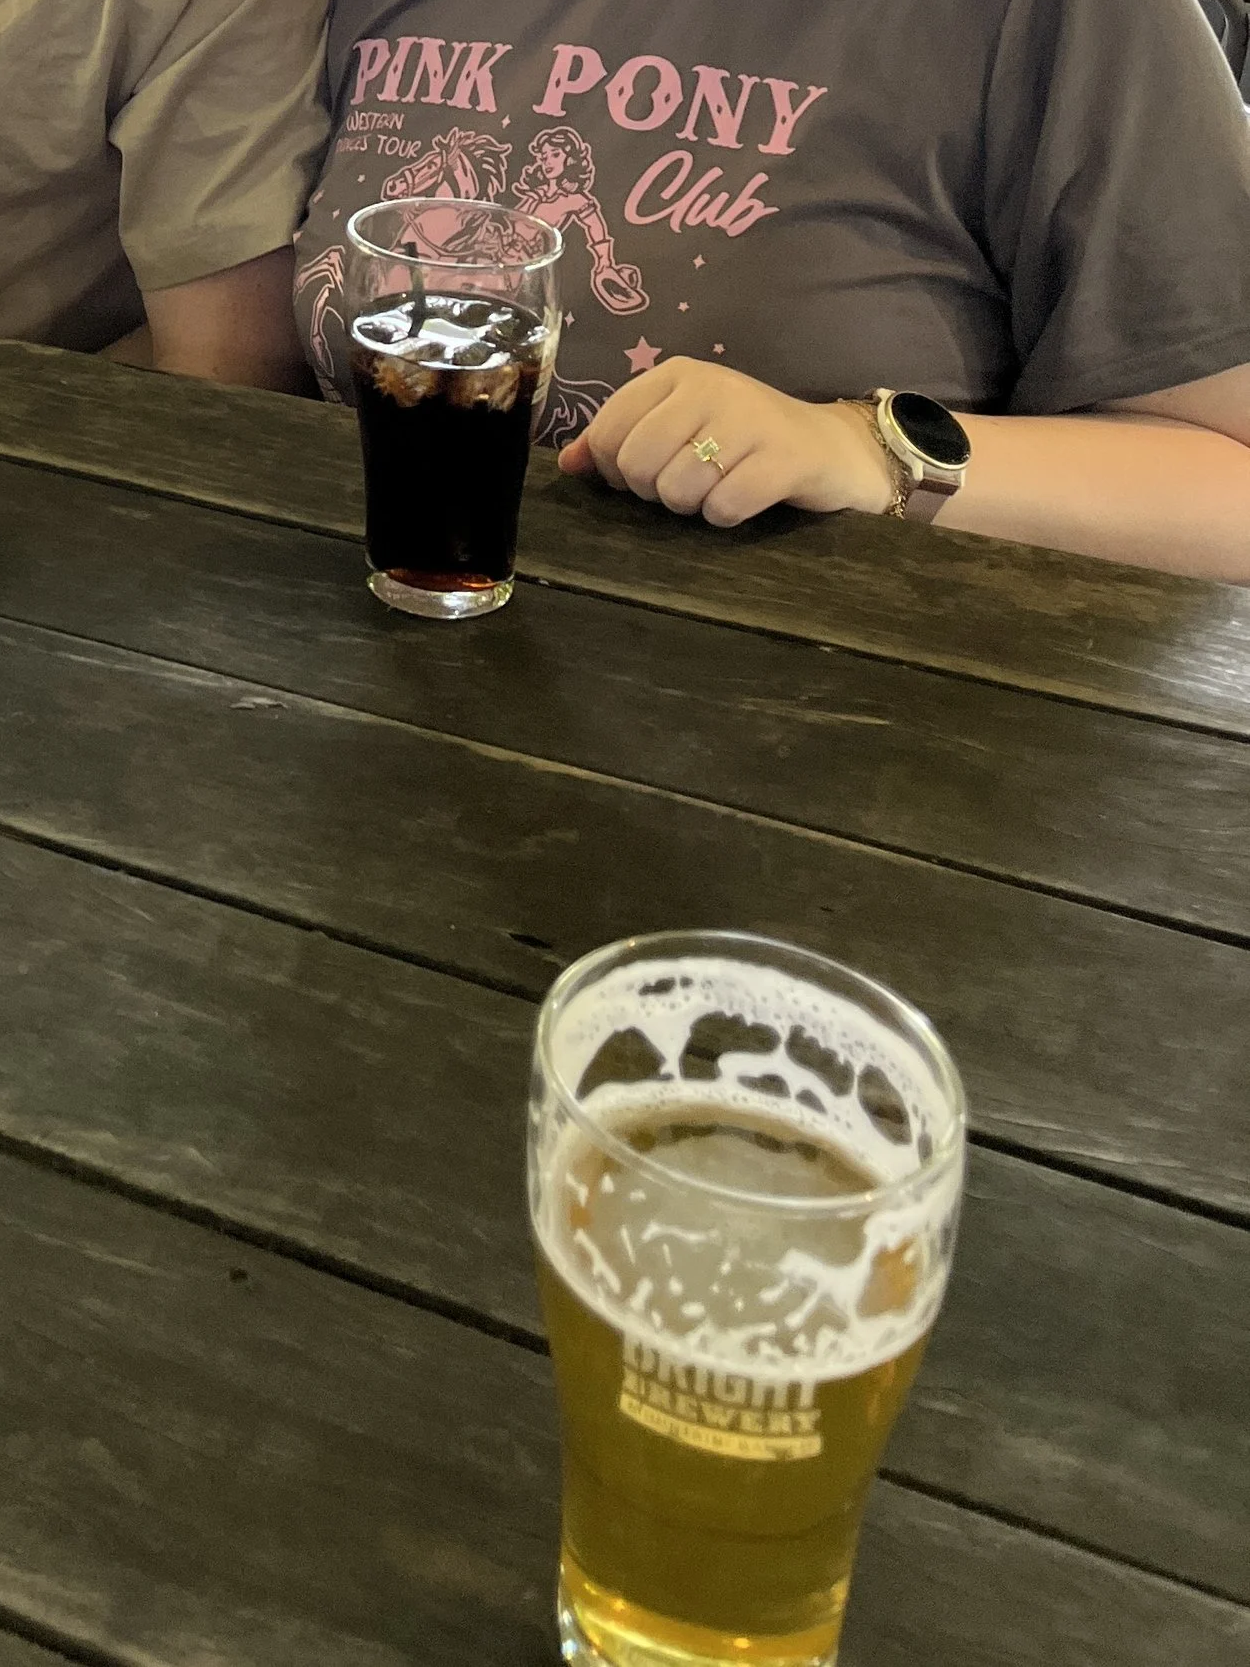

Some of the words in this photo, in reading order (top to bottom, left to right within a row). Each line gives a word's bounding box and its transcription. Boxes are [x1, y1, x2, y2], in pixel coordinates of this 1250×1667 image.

[350, 36, 513, 113] PINK
[532, 43, 828, 155] PONY
[377, 135, 422, 159] TOUR
[624, 149, 779, 237] Club
